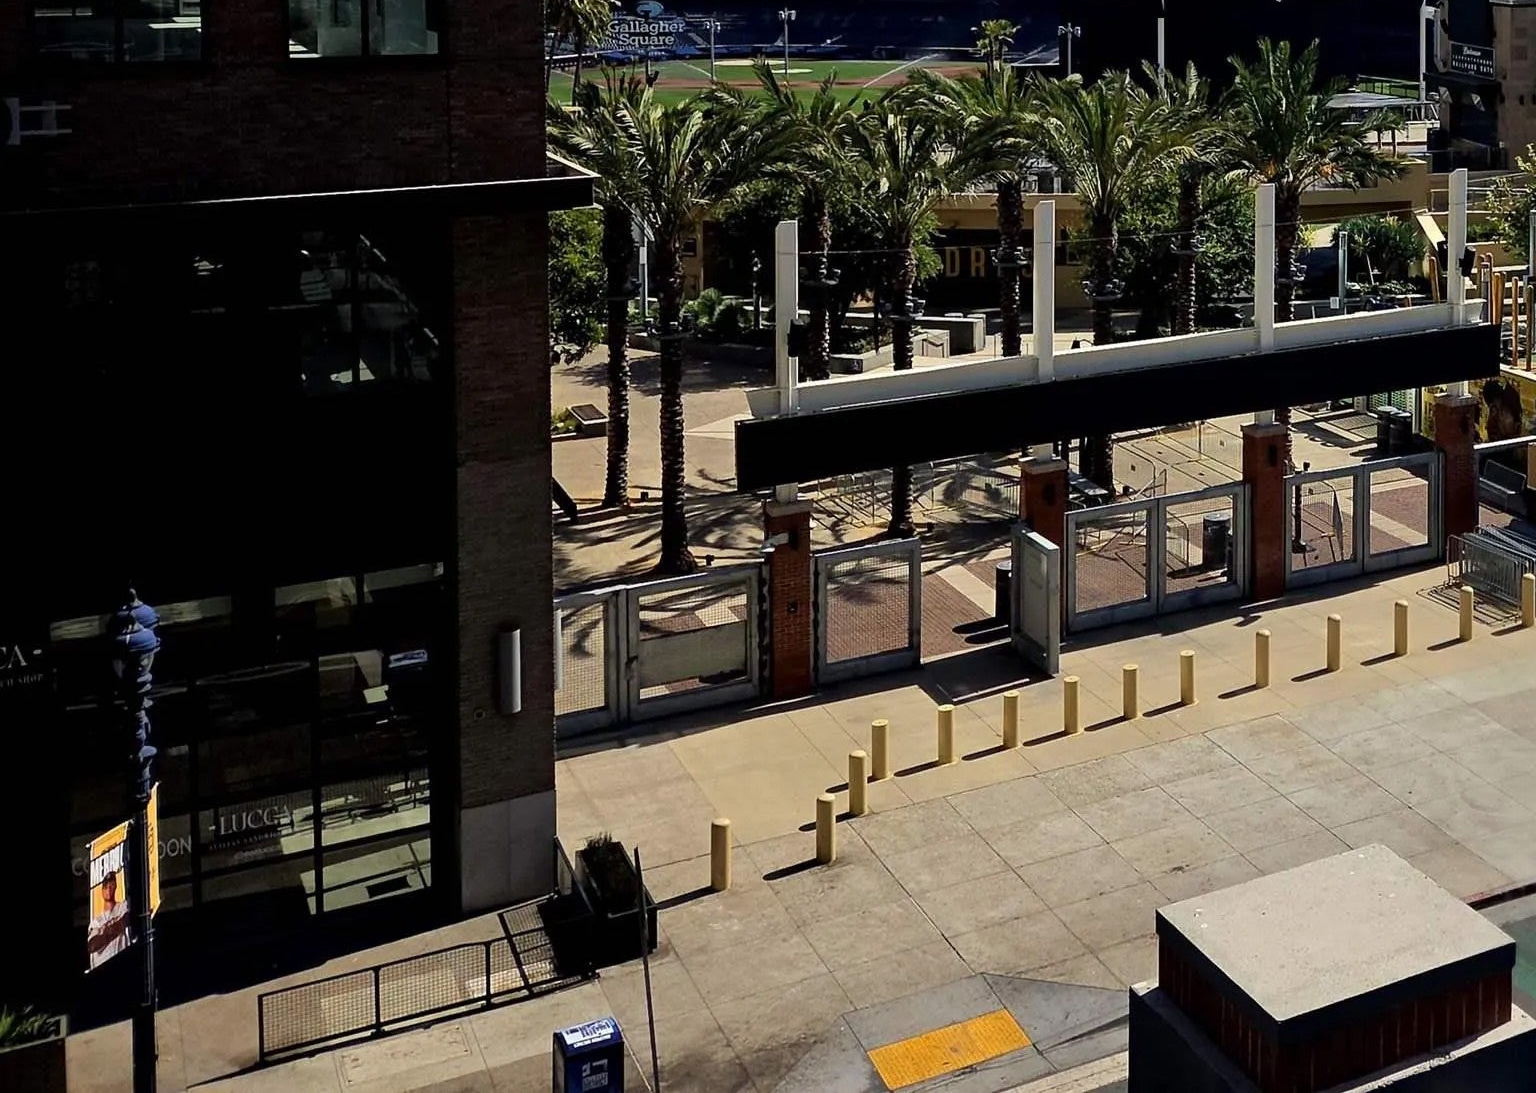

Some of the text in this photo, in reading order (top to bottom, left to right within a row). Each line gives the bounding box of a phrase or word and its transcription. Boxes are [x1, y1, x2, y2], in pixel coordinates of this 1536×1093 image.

[607, 19, 686, 36] Gallagher
[619, 33, 675, 48] Square
[219, 804, 292, 836] LUCCA
